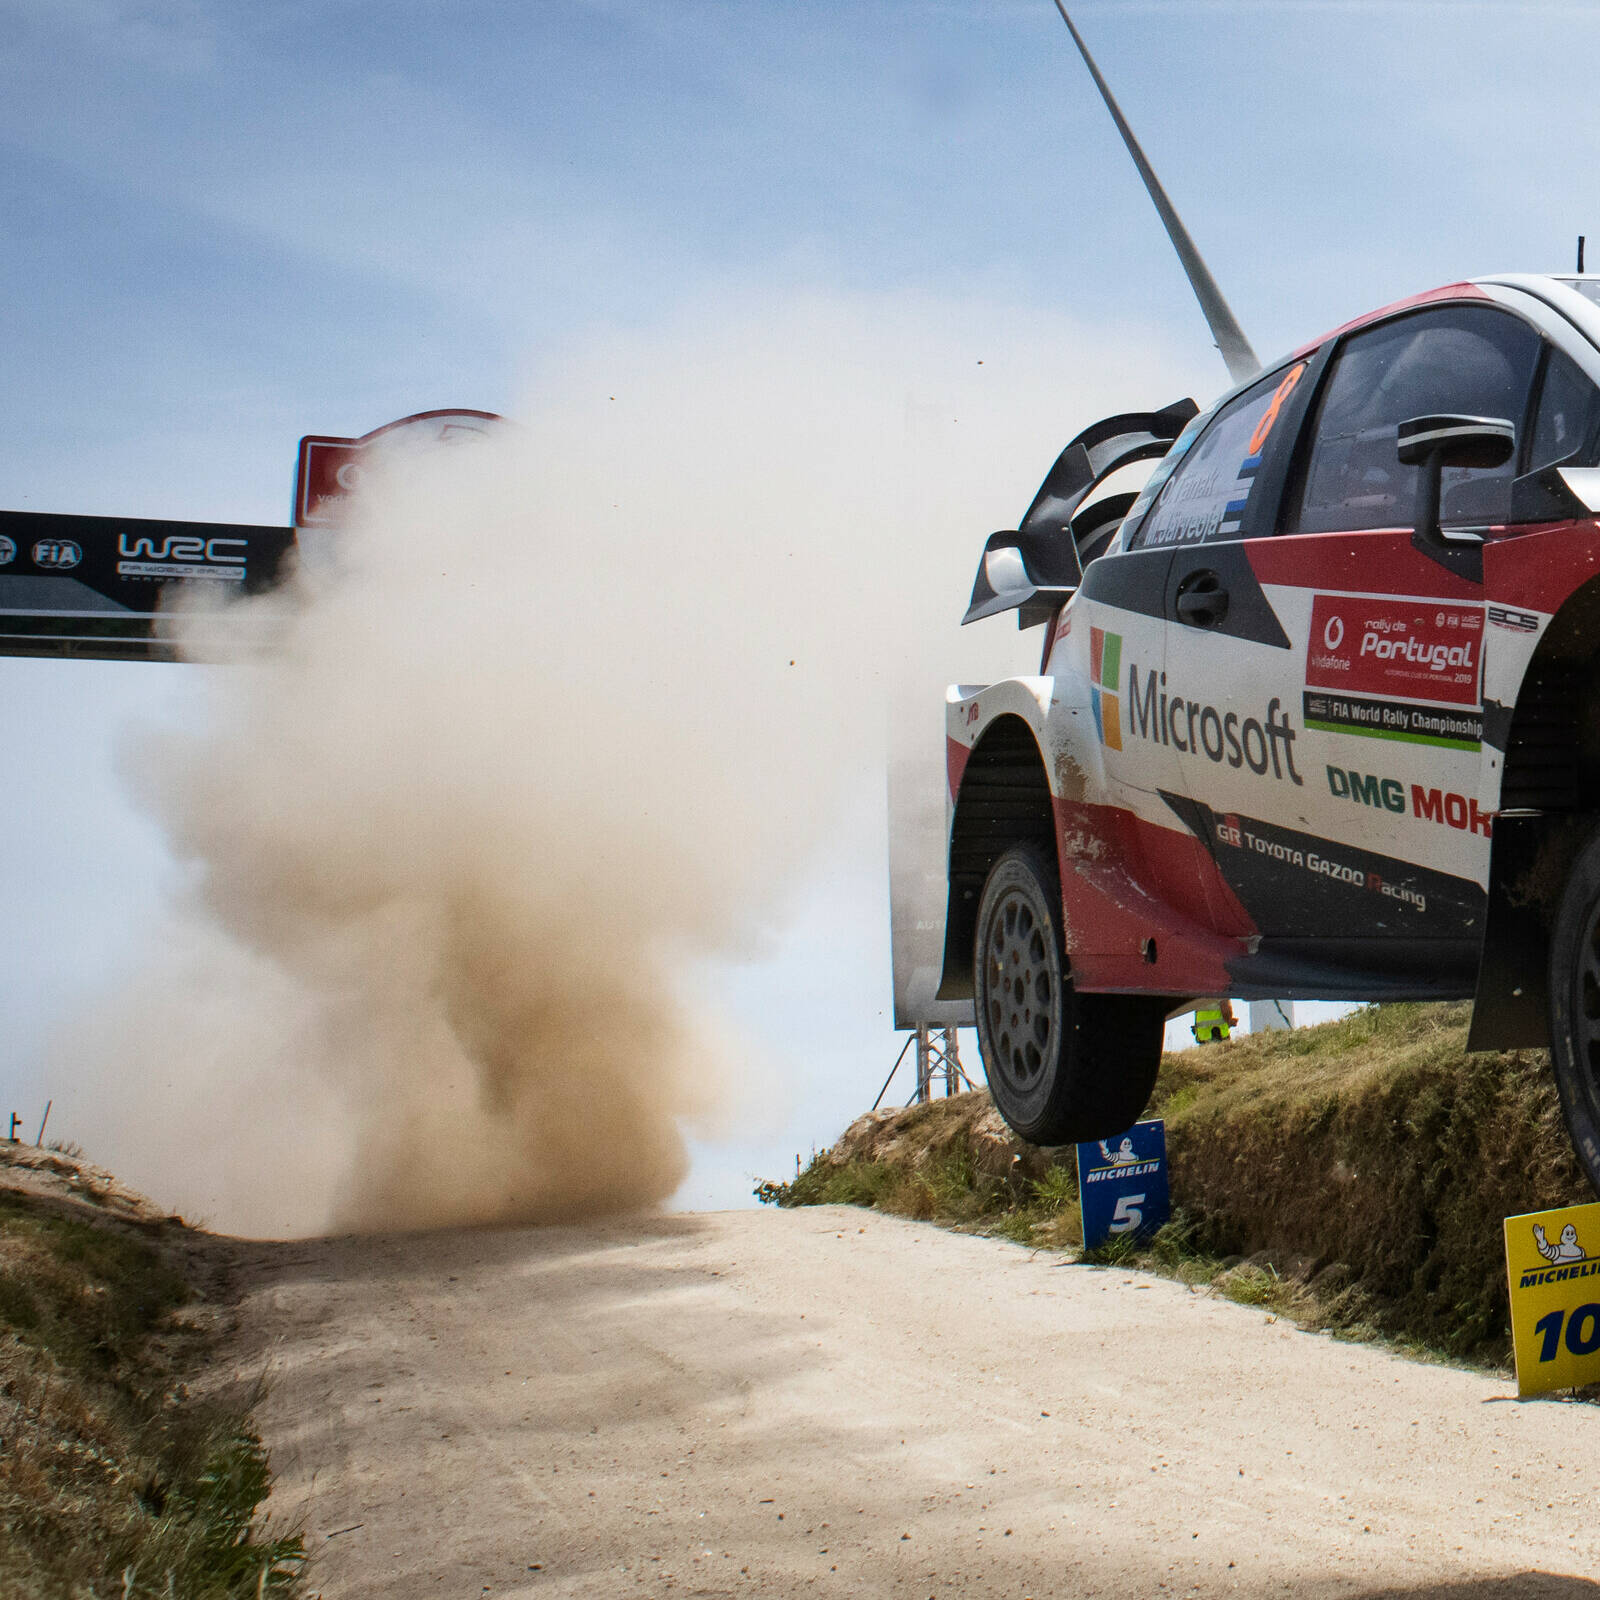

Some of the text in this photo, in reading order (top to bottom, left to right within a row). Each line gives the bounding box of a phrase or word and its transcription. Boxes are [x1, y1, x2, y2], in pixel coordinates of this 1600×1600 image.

[1249, 364, 1304, 455] 8
[35, 544, 77, 563] FIA
[118, 533, 248, 562] WRC
[1365, 618, 1407, 633] rally de
[1360, 633, 1473, 671] Portugal
[1454, 673, 1473, 684] 2019
[1129, 664, 1303, 786] Microsoft
[1333, 702, 1483, 739] FIA World Rally Championship
[1326, 764, 1406, 814] DMG
[1216, 824, 1426, 912] GR TOYOTA GAZOO Racing
[1086, 1161, 1160, 1184] MICHELIN
[1109, 1193, 1146, 1234] 5
